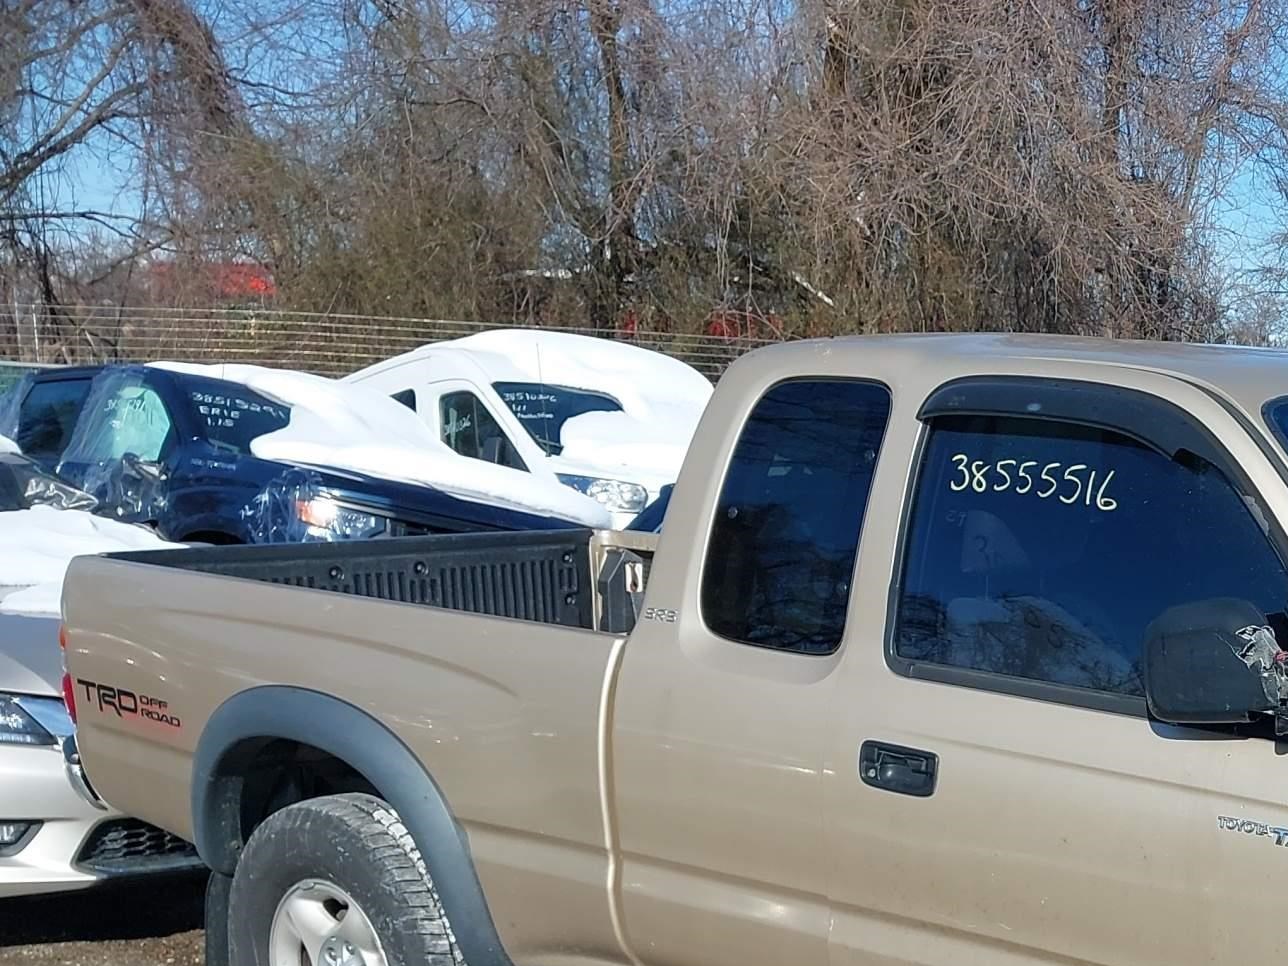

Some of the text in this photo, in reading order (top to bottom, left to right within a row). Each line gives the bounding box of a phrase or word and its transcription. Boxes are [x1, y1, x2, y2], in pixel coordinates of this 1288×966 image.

[950, 453, 1118, 511] 38555516
[77, 678, 138, 718] TRD
[139, 694, 169, 710] OFF
[140, 707, 181, 728] ROAD
[1217, 815, 1271, 837] TOYOTA
